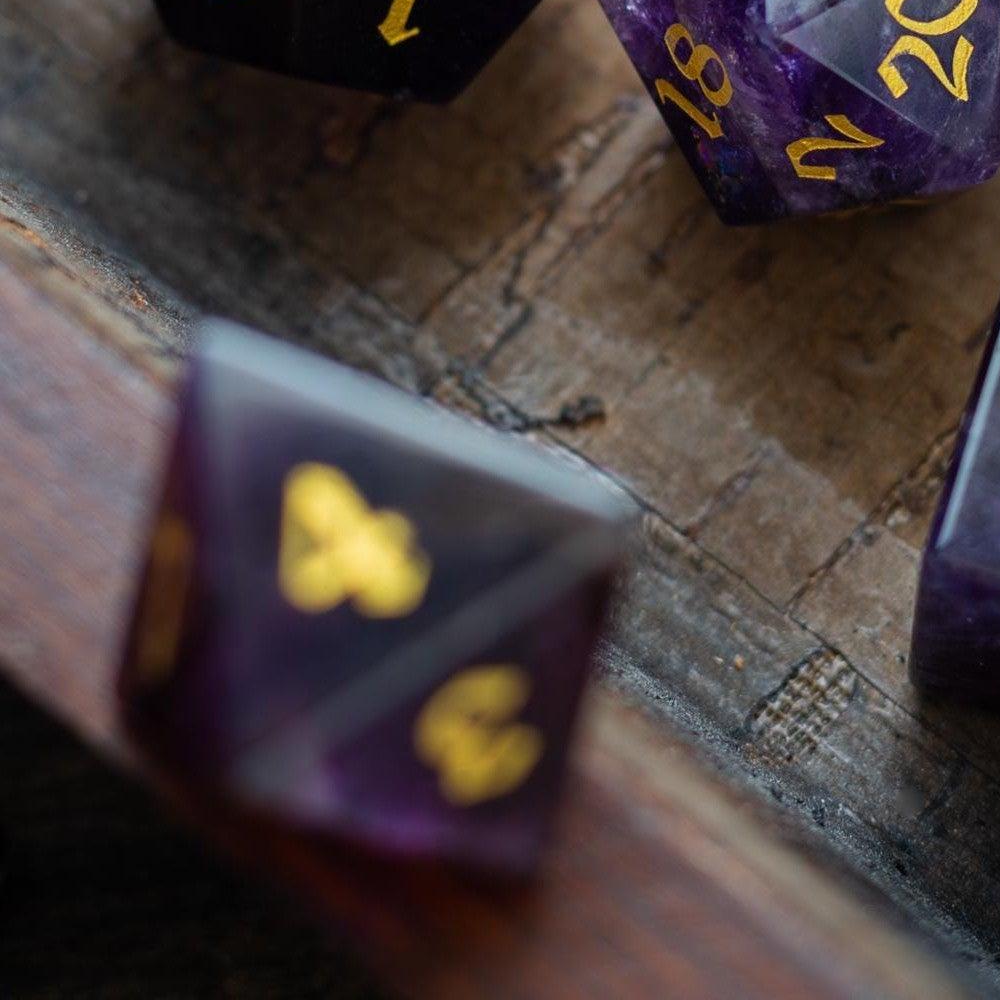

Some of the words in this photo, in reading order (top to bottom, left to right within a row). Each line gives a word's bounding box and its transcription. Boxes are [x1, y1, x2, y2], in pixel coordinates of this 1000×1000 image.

[655, 22, 734, 140] 18
[785, 114, 886, 181] 2
[278, 462, 431, 618] 4
